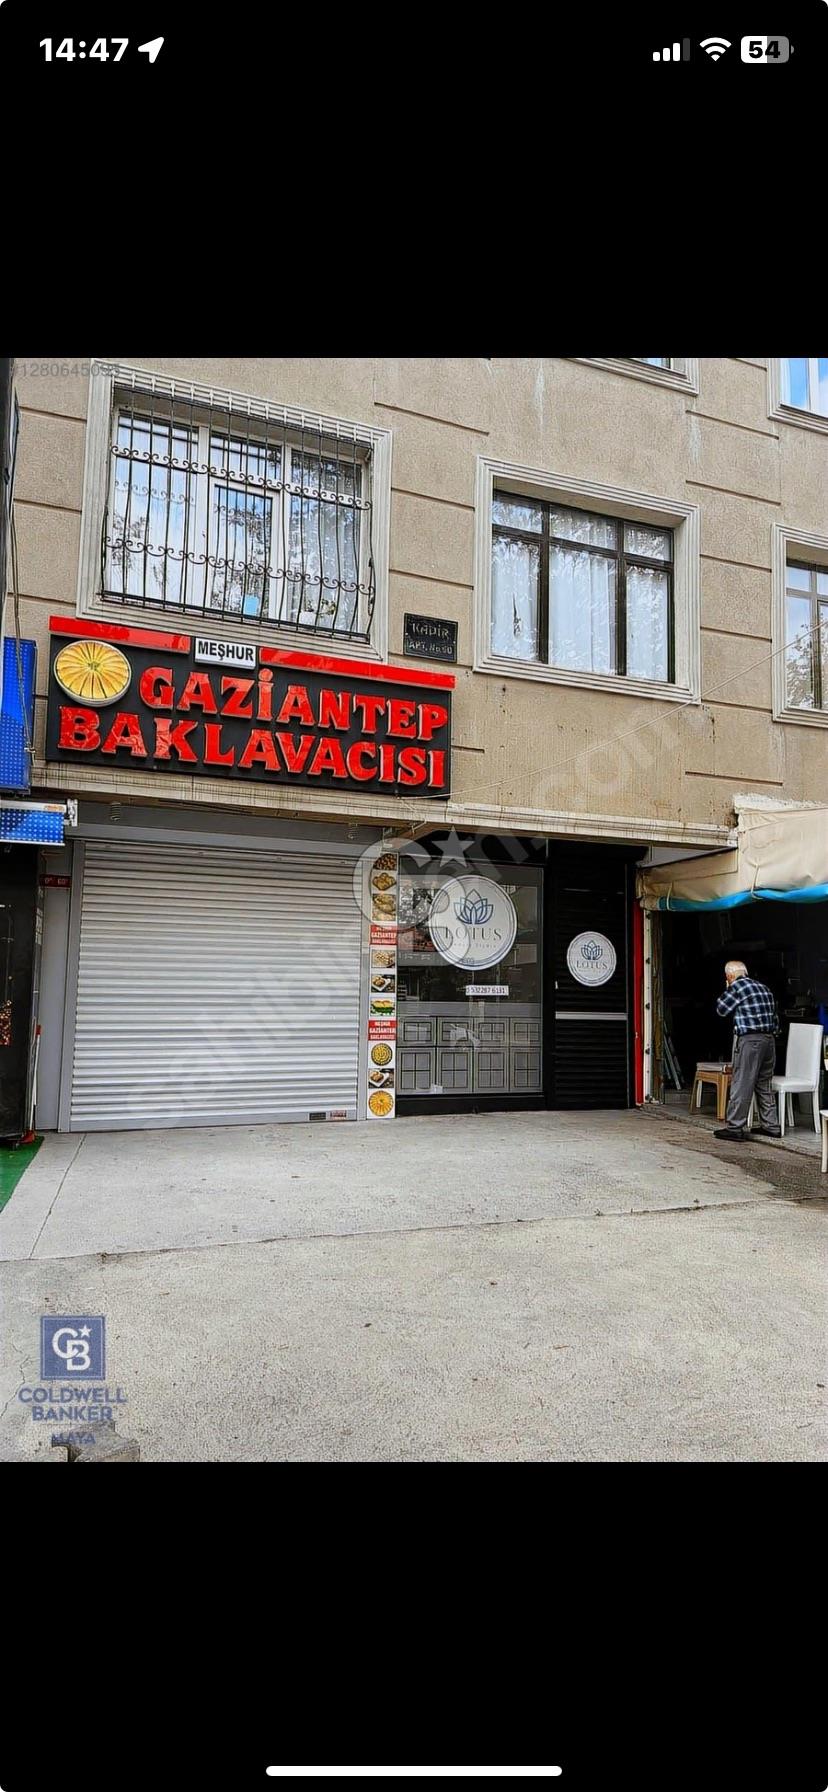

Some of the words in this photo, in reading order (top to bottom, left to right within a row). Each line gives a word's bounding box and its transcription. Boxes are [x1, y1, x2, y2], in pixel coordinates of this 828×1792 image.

[198, 640, 254, 661] MEŞHUR
[138, 667, 449, 741] GAZİANTEP
[57, 705, 447, 788] BAKLAVACISI
[444, 927, 502, 940] LOTUS
